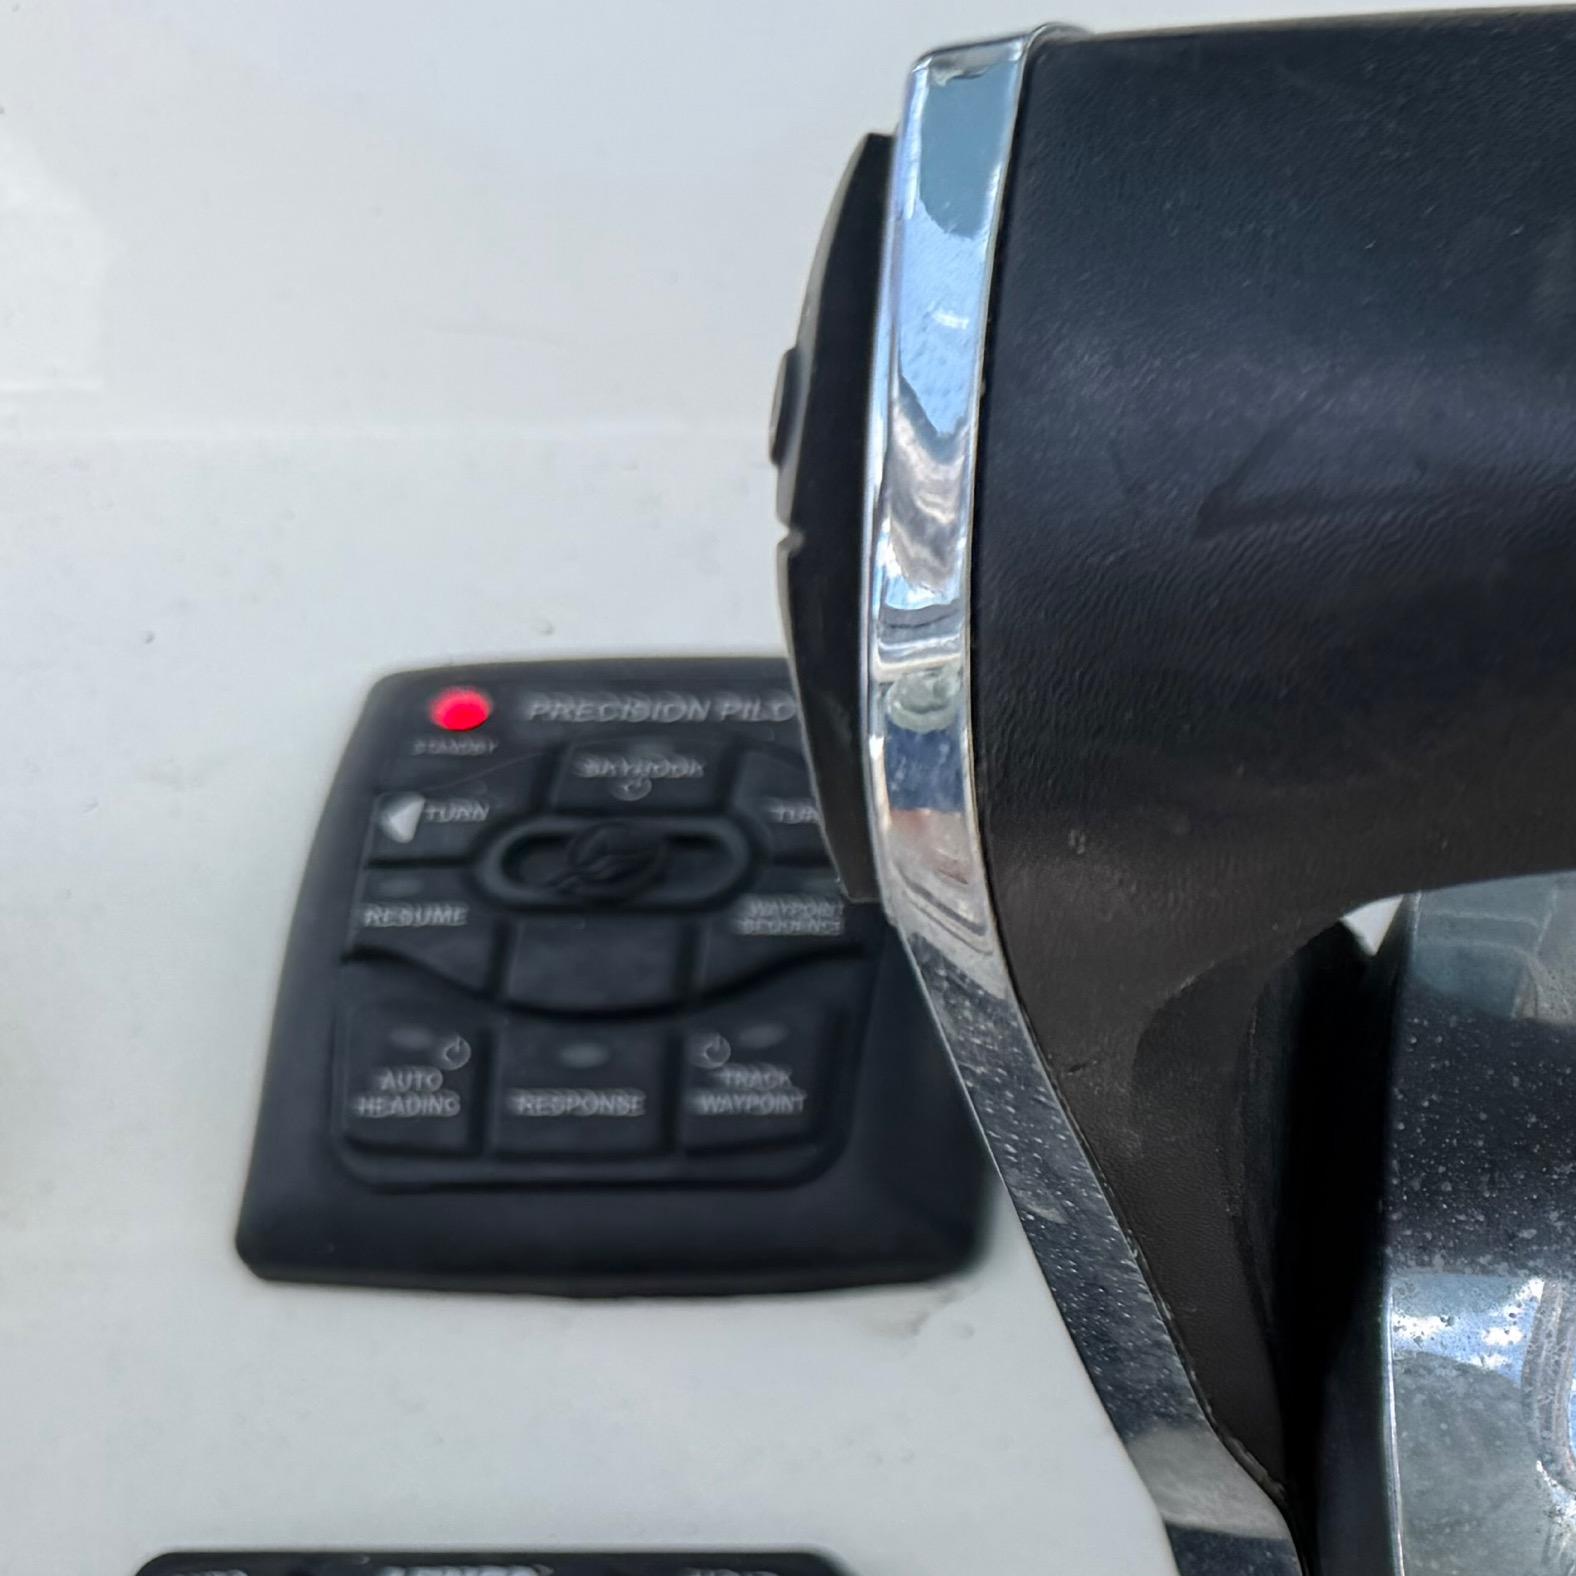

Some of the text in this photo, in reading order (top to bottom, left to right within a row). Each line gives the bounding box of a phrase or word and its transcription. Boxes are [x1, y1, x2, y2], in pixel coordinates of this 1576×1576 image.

[524, 692, 711, 722] PRECISION
[424, 799, 489, 822] TURN
[378, 1066, 443, 1092] AUTO
[354, 1090, 460, 1117] HEADING
[508, 1088, 647, 1116] RESPONSE
